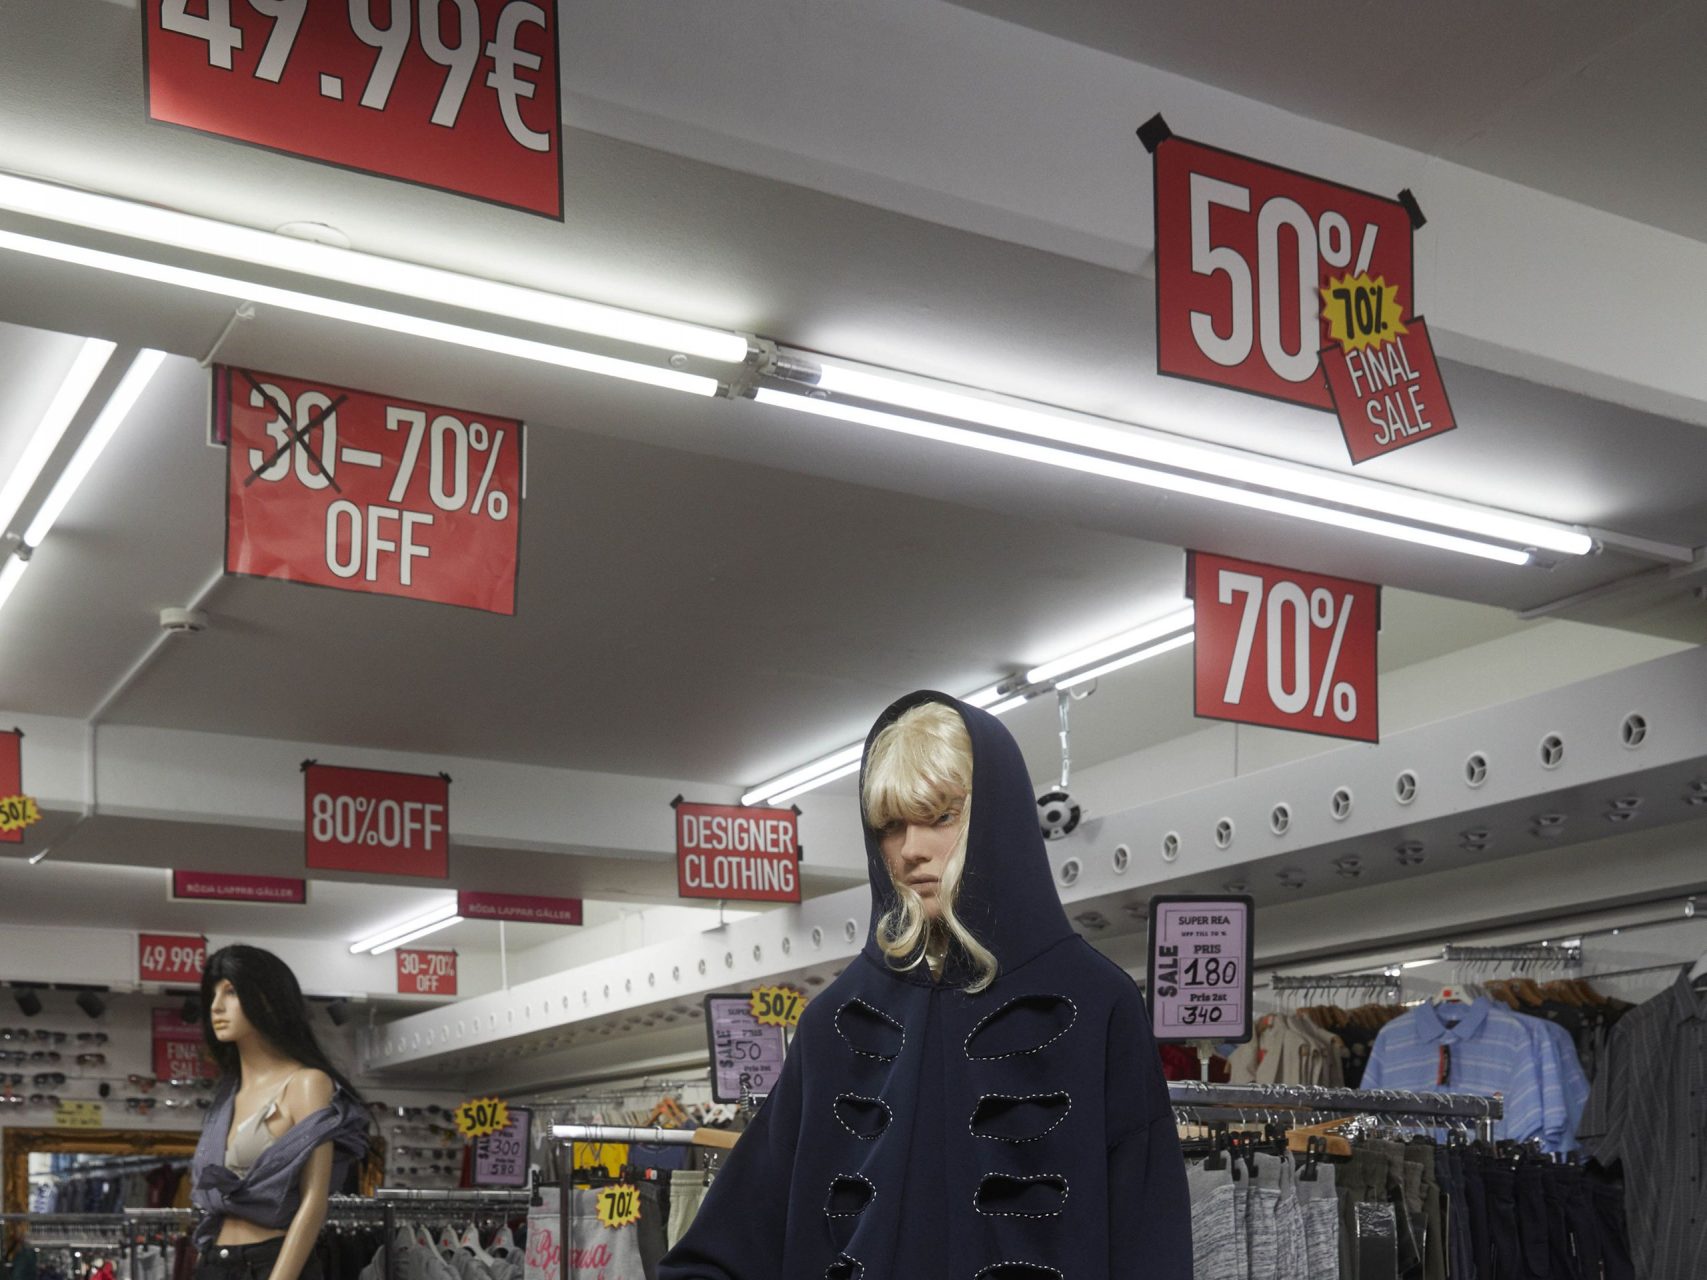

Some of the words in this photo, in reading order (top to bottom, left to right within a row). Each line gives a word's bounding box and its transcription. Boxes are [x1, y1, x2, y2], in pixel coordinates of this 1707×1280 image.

[1333, 285, 1388, 340] 70%
[1346, 336, 1420, 398] FINAL
[1366, 385, 1431, 445] SALE
[325, 500, 434, 586] OFF
[1218, 569, 1357, 722] 70%
[683, 815, 794, 853] DESIGNER
[685, 854, 794, 892] CLOTHING
[1178, 915, 1209, 926] SUPER
[1211, 915, 1231, 925] REA
[142, 944, 205, 973] 49.99€
[1193, 944, 1222, 954] PRIS
[416, 974, 439, 992] OFF
[1157, 945, 1178, 997] SALE
[1184, 958, 1237, 986] 180
[759, 992, 798, 1021] 50%
[1190, 993, 1211, 1002] Pris
[1182, 1006, 1222, 1025] 340
[463, 1103, 500, 1131] 50%
[604, 1192, 633, 1219] 70%
